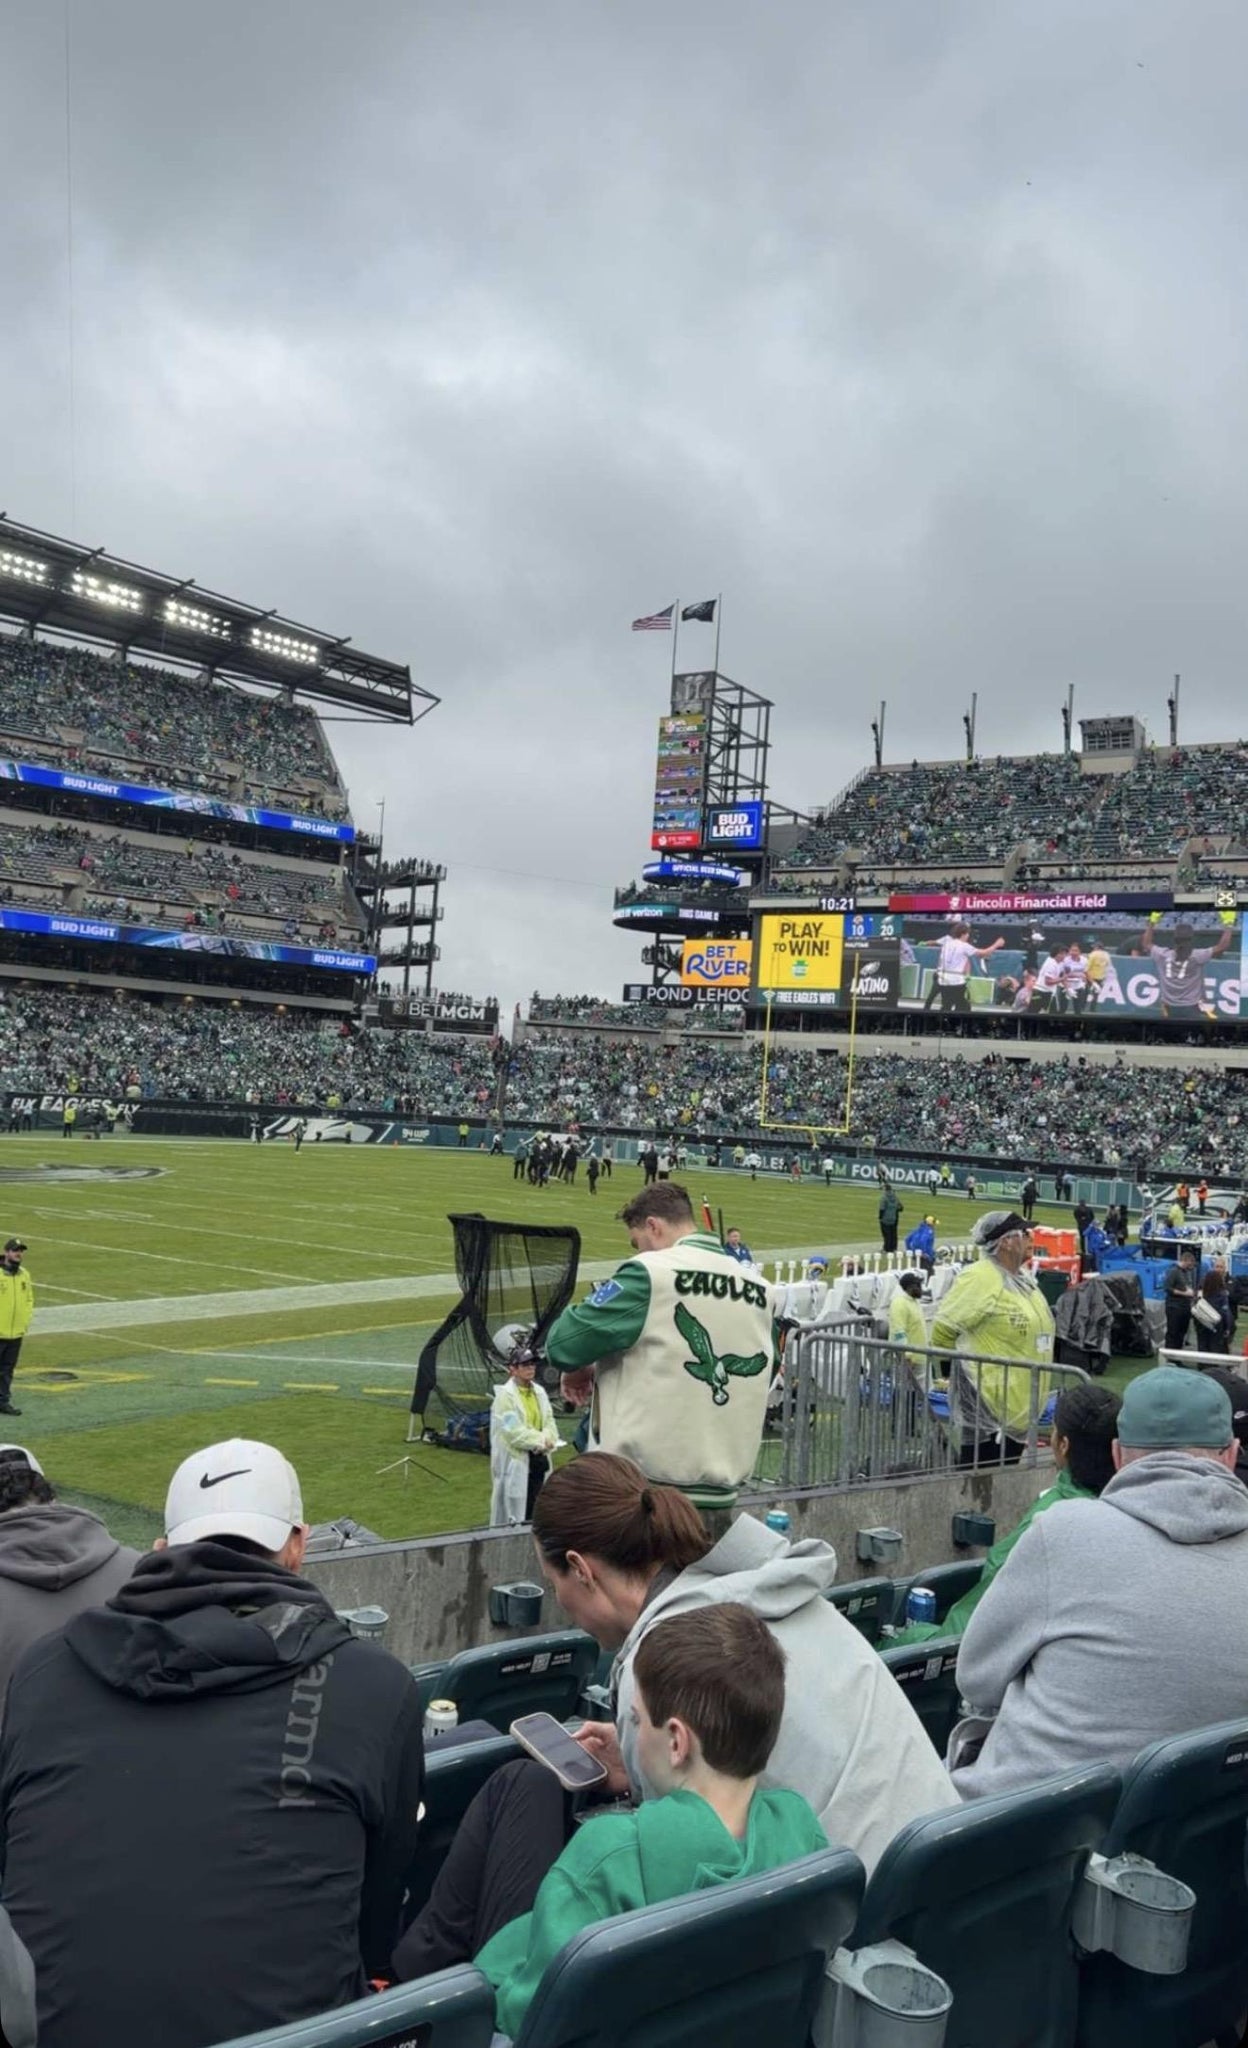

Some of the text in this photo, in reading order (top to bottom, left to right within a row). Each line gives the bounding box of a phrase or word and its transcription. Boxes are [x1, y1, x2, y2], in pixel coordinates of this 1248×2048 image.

[63, 776, 119, 794] BUD LIGHT
[718, 814, 749, 825] BUD
[292, 820, 338, 836] BUD LIGHT
[712, 825, 753, 838] LIGHT
[820, 898, 855, 910] 10:21
[965, 895, 1107, 909] Lincoln Financial Field
[632, 908, 664, 918] verizon
[51, 920, 116, 938] BUD LIGHT
[780, 921, 824, 938] PLAY
[851, 924, 865, 936] 10
[880, 924, 895, 937] 20
[706, 945, 736, 958] BET
[773, 940, 830, 957] TO WIN!
[313, 953, 366, 968] BUD LIGHT
[686, 954, 750, 980] RIVER
[850, 977, 889, 995] LATINO
[646, 987, 692, 1001] POND
[409, 1002, 485, 1020] BETMGM
[116, 1103, 140, 1115] FLY
[674, 1270, 768, 1309] EAGLES
